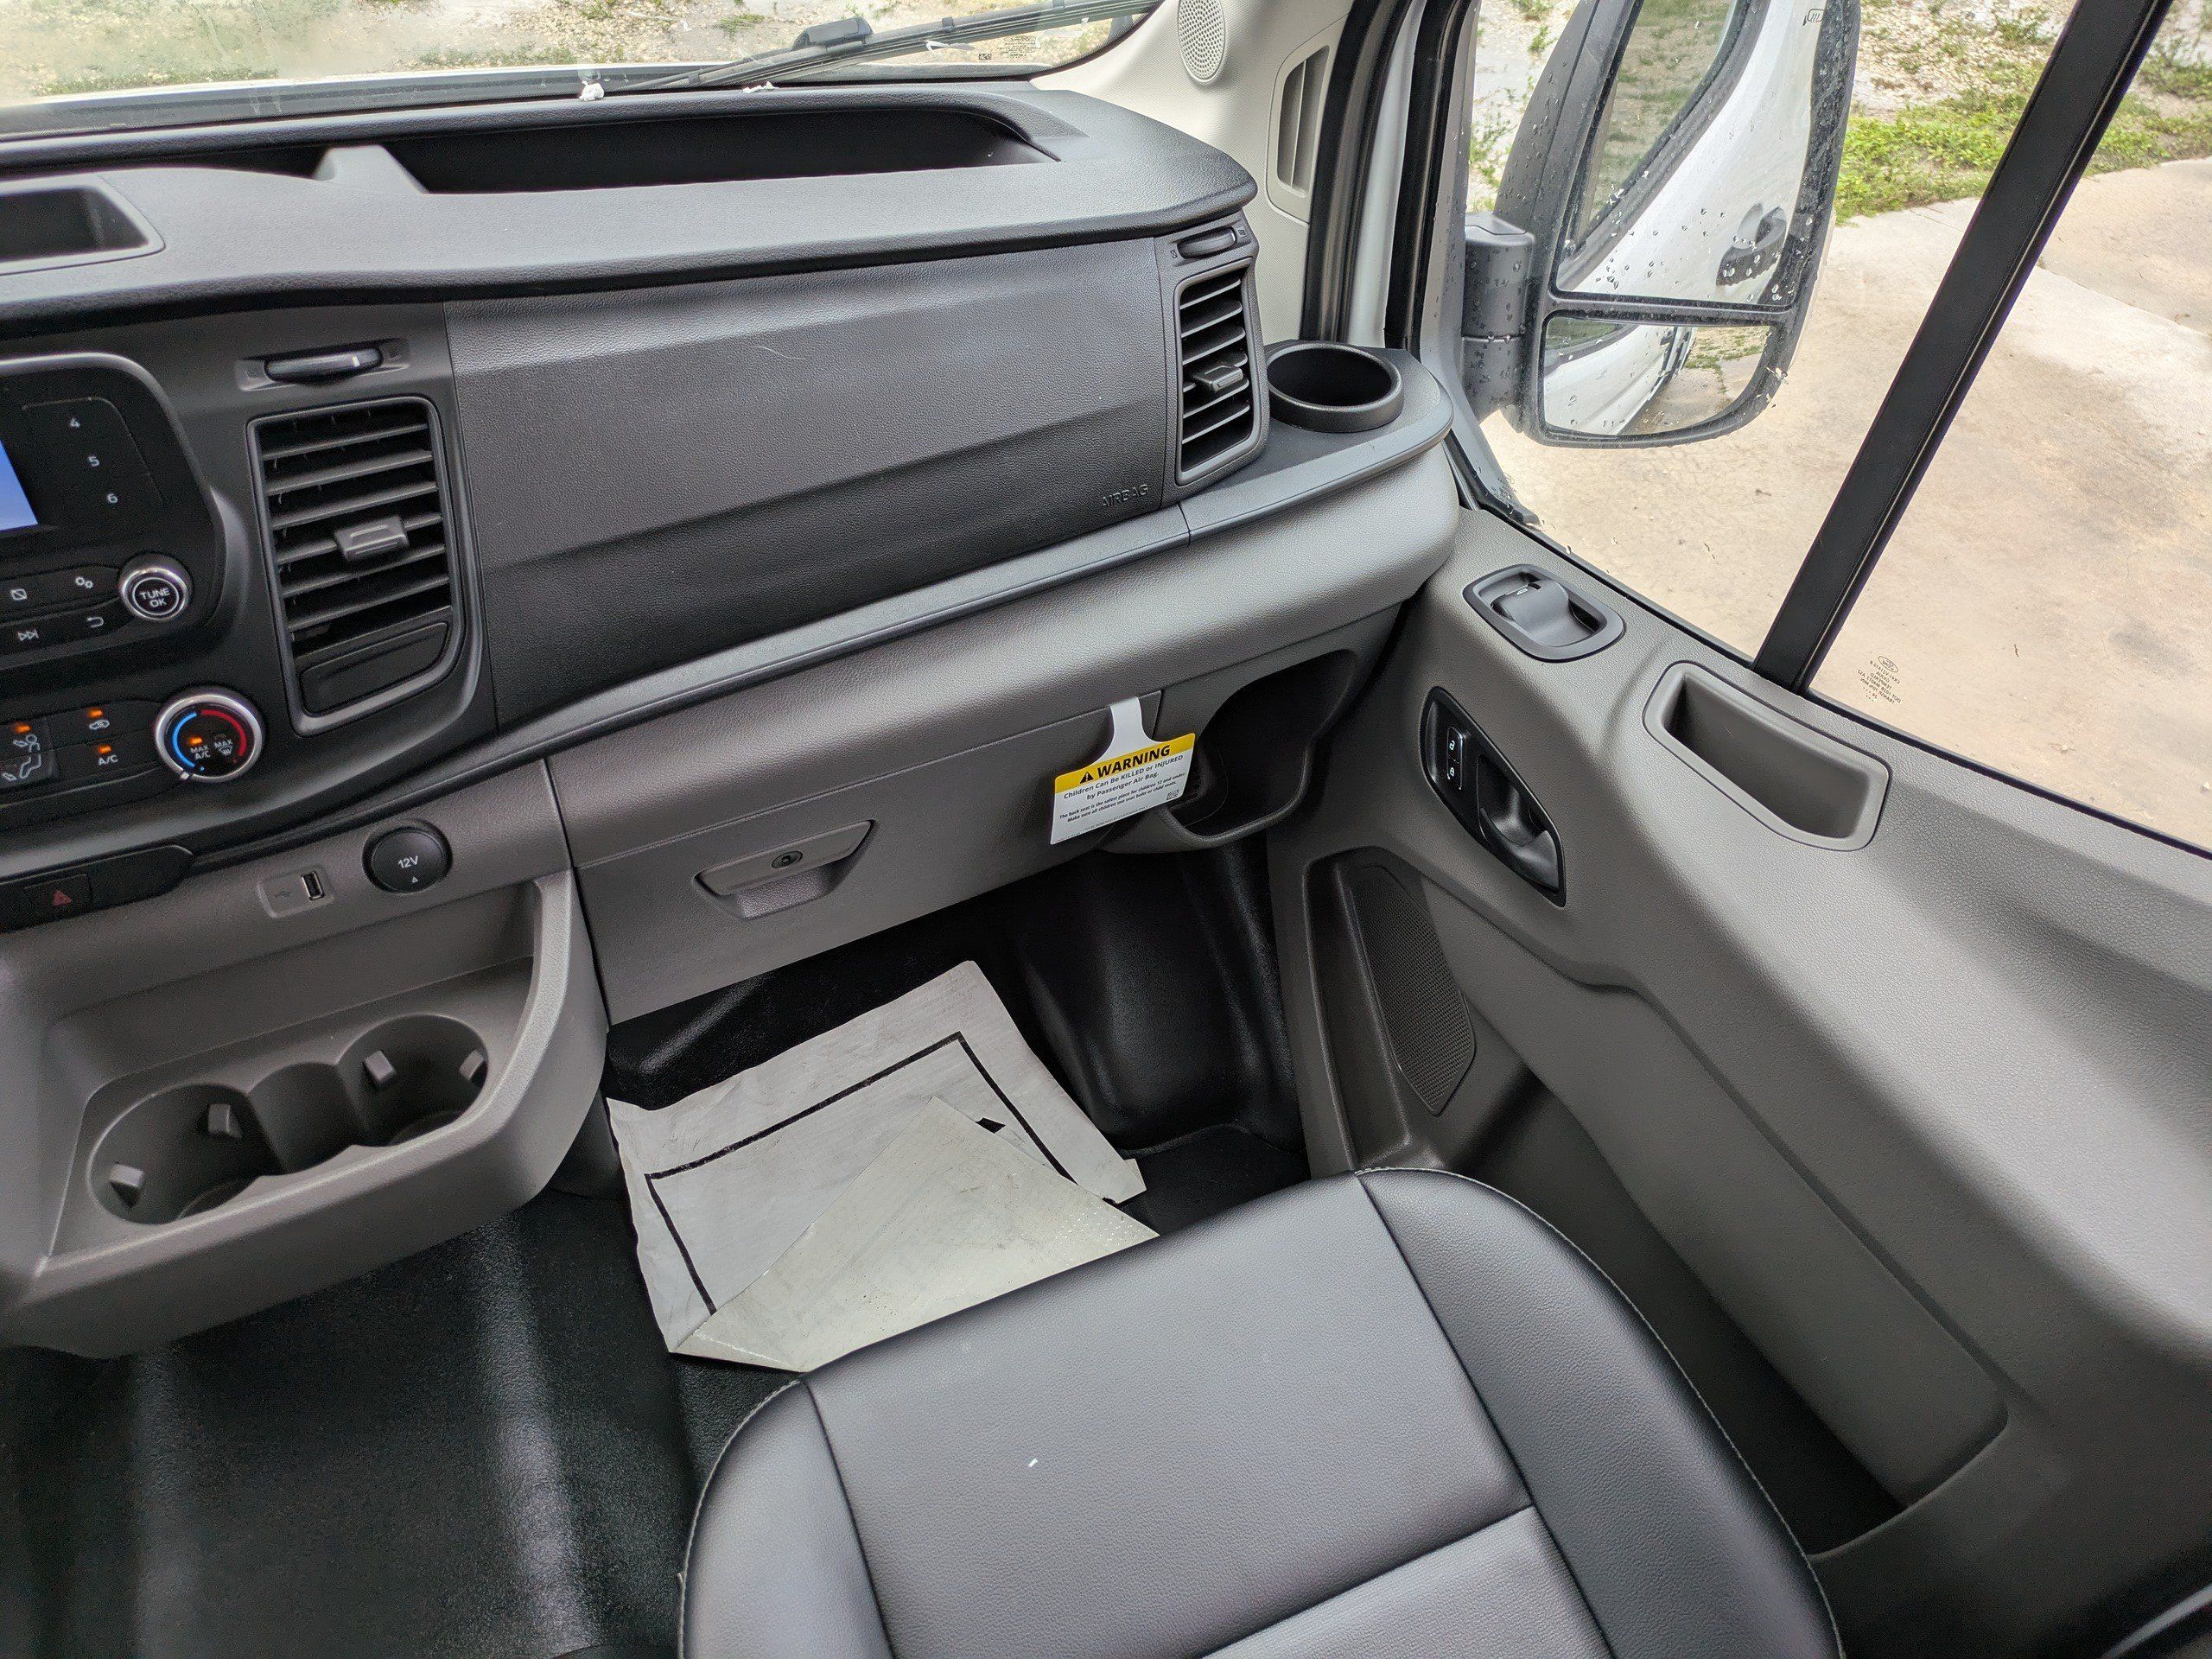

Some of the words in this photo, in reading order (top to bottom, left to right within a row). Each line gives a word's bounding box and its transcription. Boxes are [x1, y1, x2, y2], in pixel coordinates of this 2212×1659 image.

[70, 417, 80, 428] 4
[88, 455, 100, 467] 5
[107, 493, 118, 504] 6
[1103, 484, 1149, 507] AIRBAG
[140, 588, 170, 600] TUNE
[149, 598, 167, 607] OK
[191, 745, 209, 753] MAX
[214, 739, 233, 748] MAX
[98, 754, 118, 766] A/C
[195, 751, 212, 760] A/C
[1096, 744, 1170, 778] WARNING
[1064, 785, 1094, 799] Children
[1121, 768, 1145, 780] KILLED
[1154, 754, 1184, 768] INJURED
[1097, 780, 1132, 796] Passenger
[1080, 804, 1090, 813] seat
[1104, 796, 1117, 804] safest
[1118, 791, 1130, 800] place
[1138, 782, 1156, 792] children
[1098, 802, 1116, 811] children
[397, 855, 418, 868] 12V
